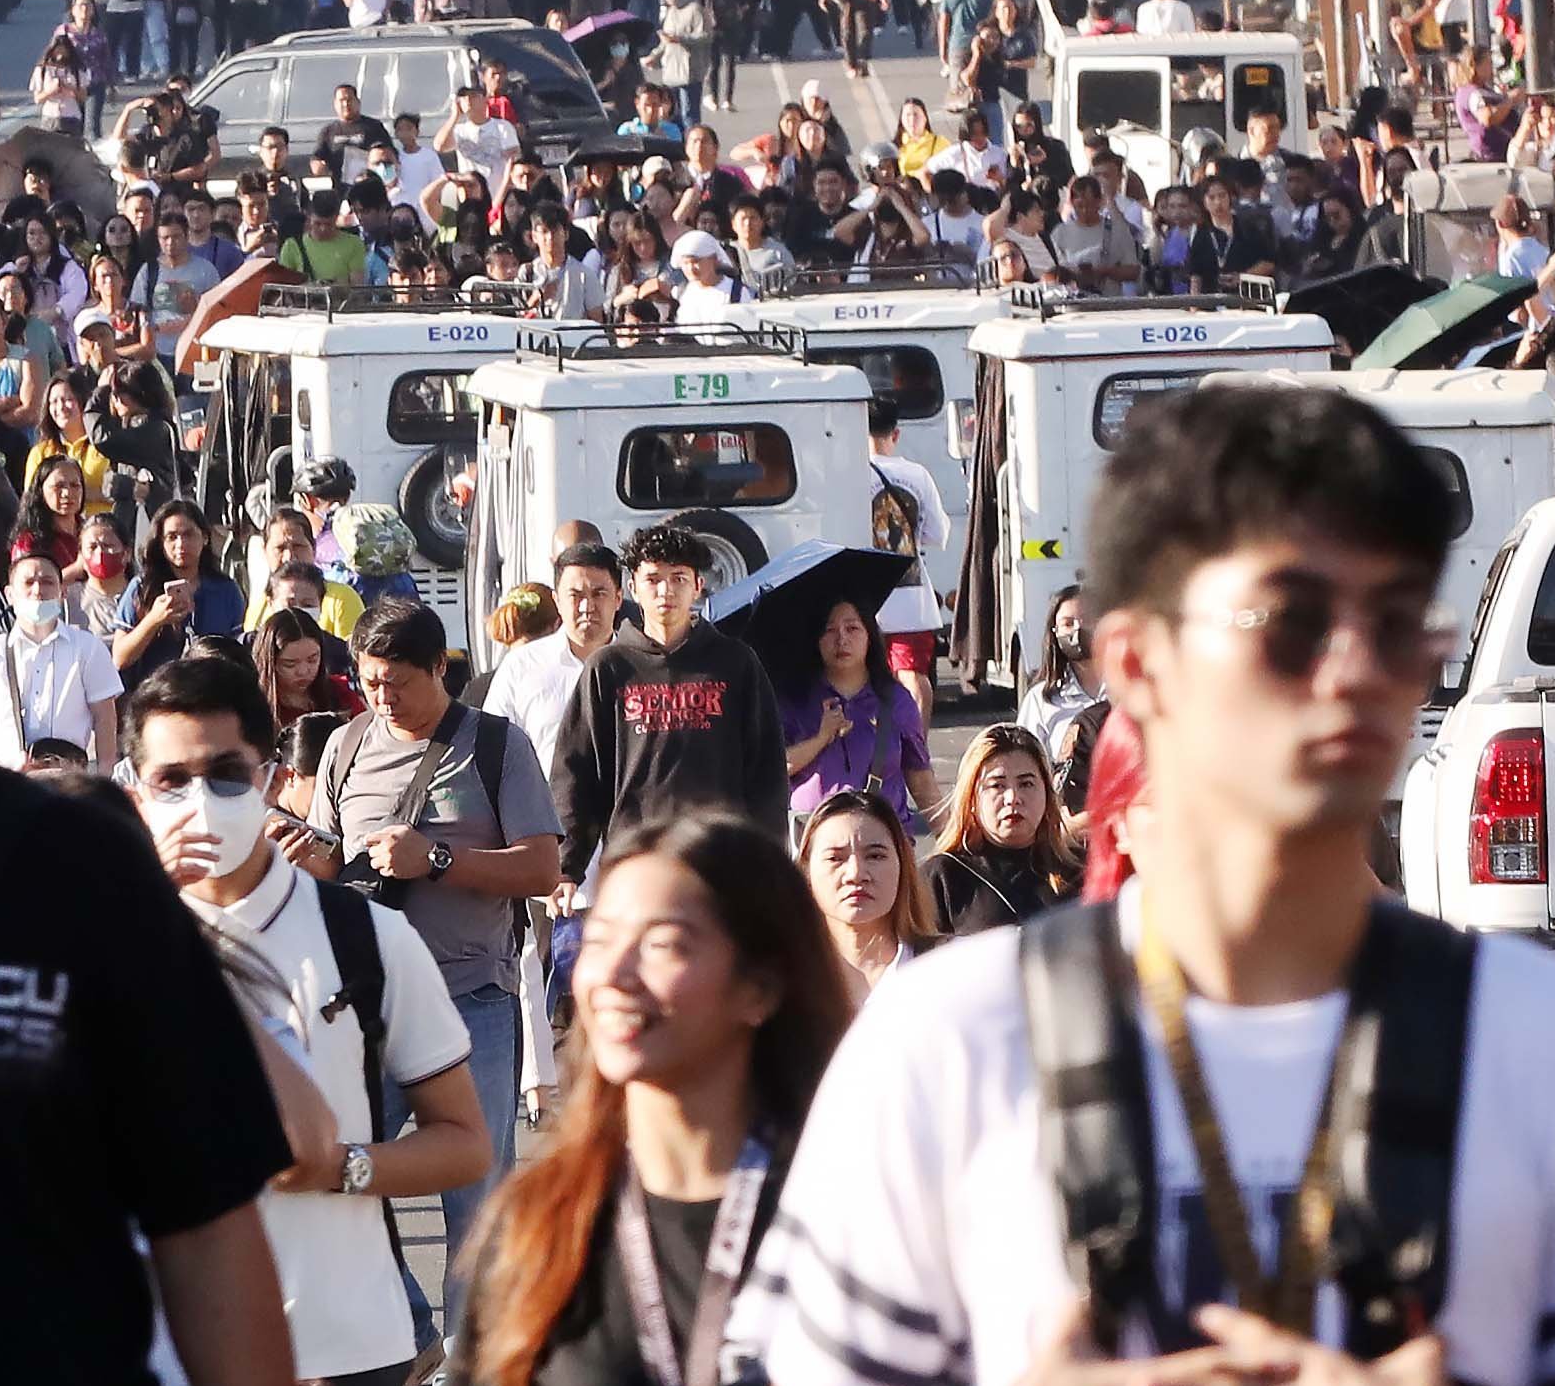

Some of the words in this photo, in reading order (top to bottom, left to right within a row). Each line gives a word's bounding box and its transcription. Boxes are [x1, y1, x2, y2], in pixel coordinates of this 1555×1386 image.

[834, 305, 895, 320] E-017
[428, 325, 489, 342] E-020
[1141, 326, 1208, 343] E-026
[674, 374, 729, 399] E-79
[624, 688, 723, 719] SENIOR
